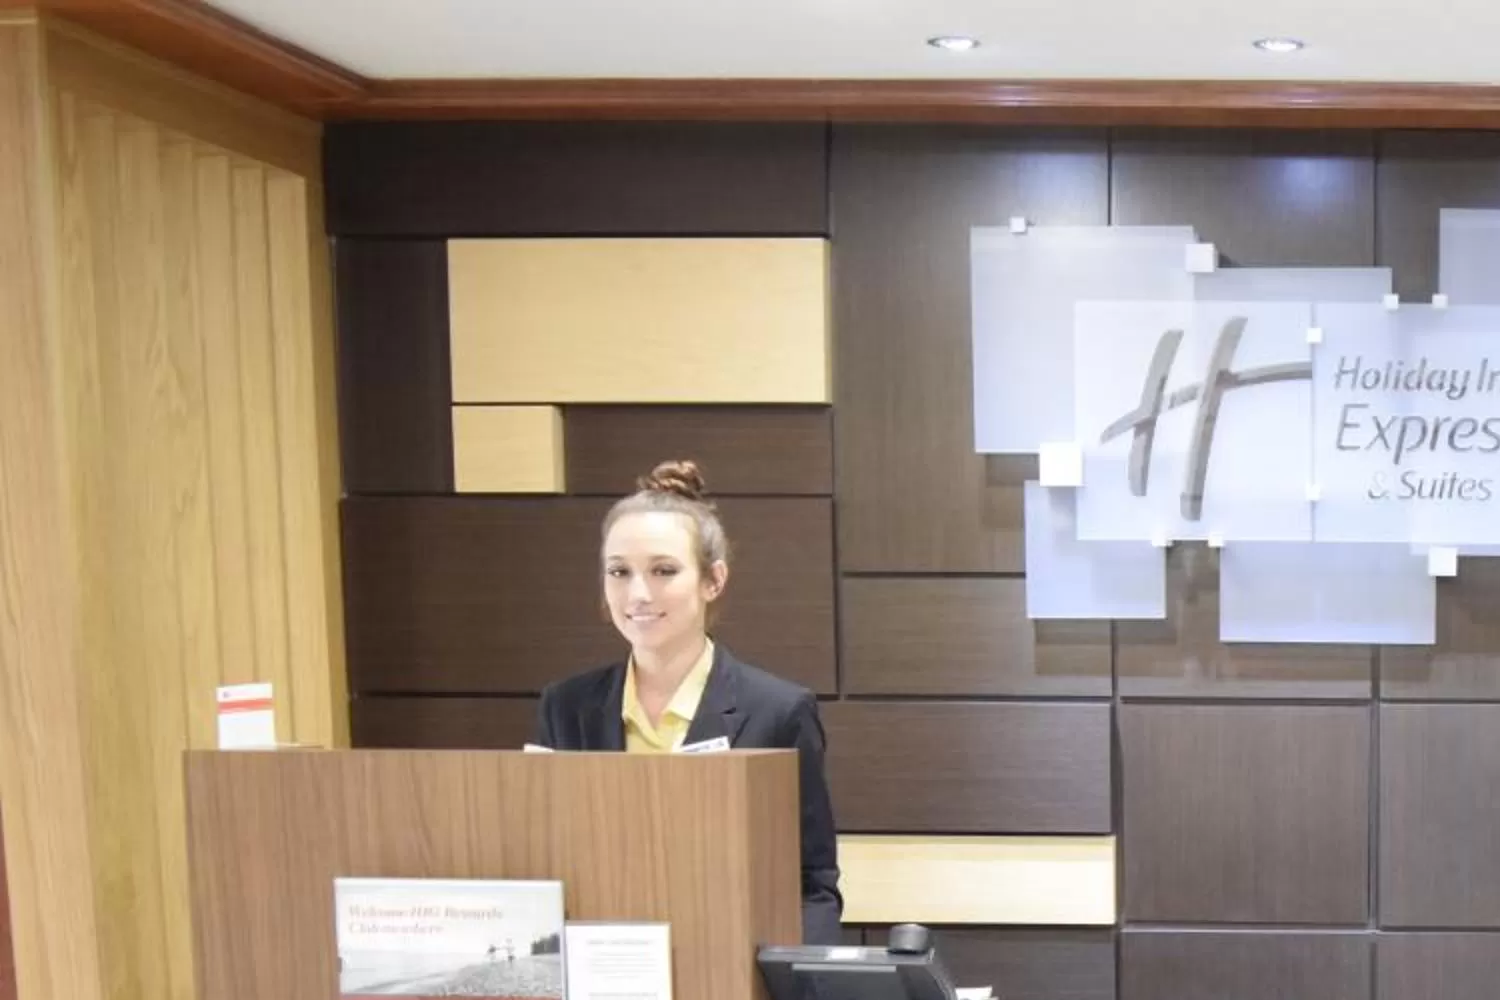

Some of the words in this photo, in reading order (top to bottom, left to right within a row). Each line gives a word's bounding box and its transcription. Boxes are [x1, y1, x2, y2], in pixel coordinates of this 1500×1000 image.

[1333, 355, 1472, 401] Holiday
[1366, 470, 1389, 500] &
[1397, 469, 1494, 501] Suites
